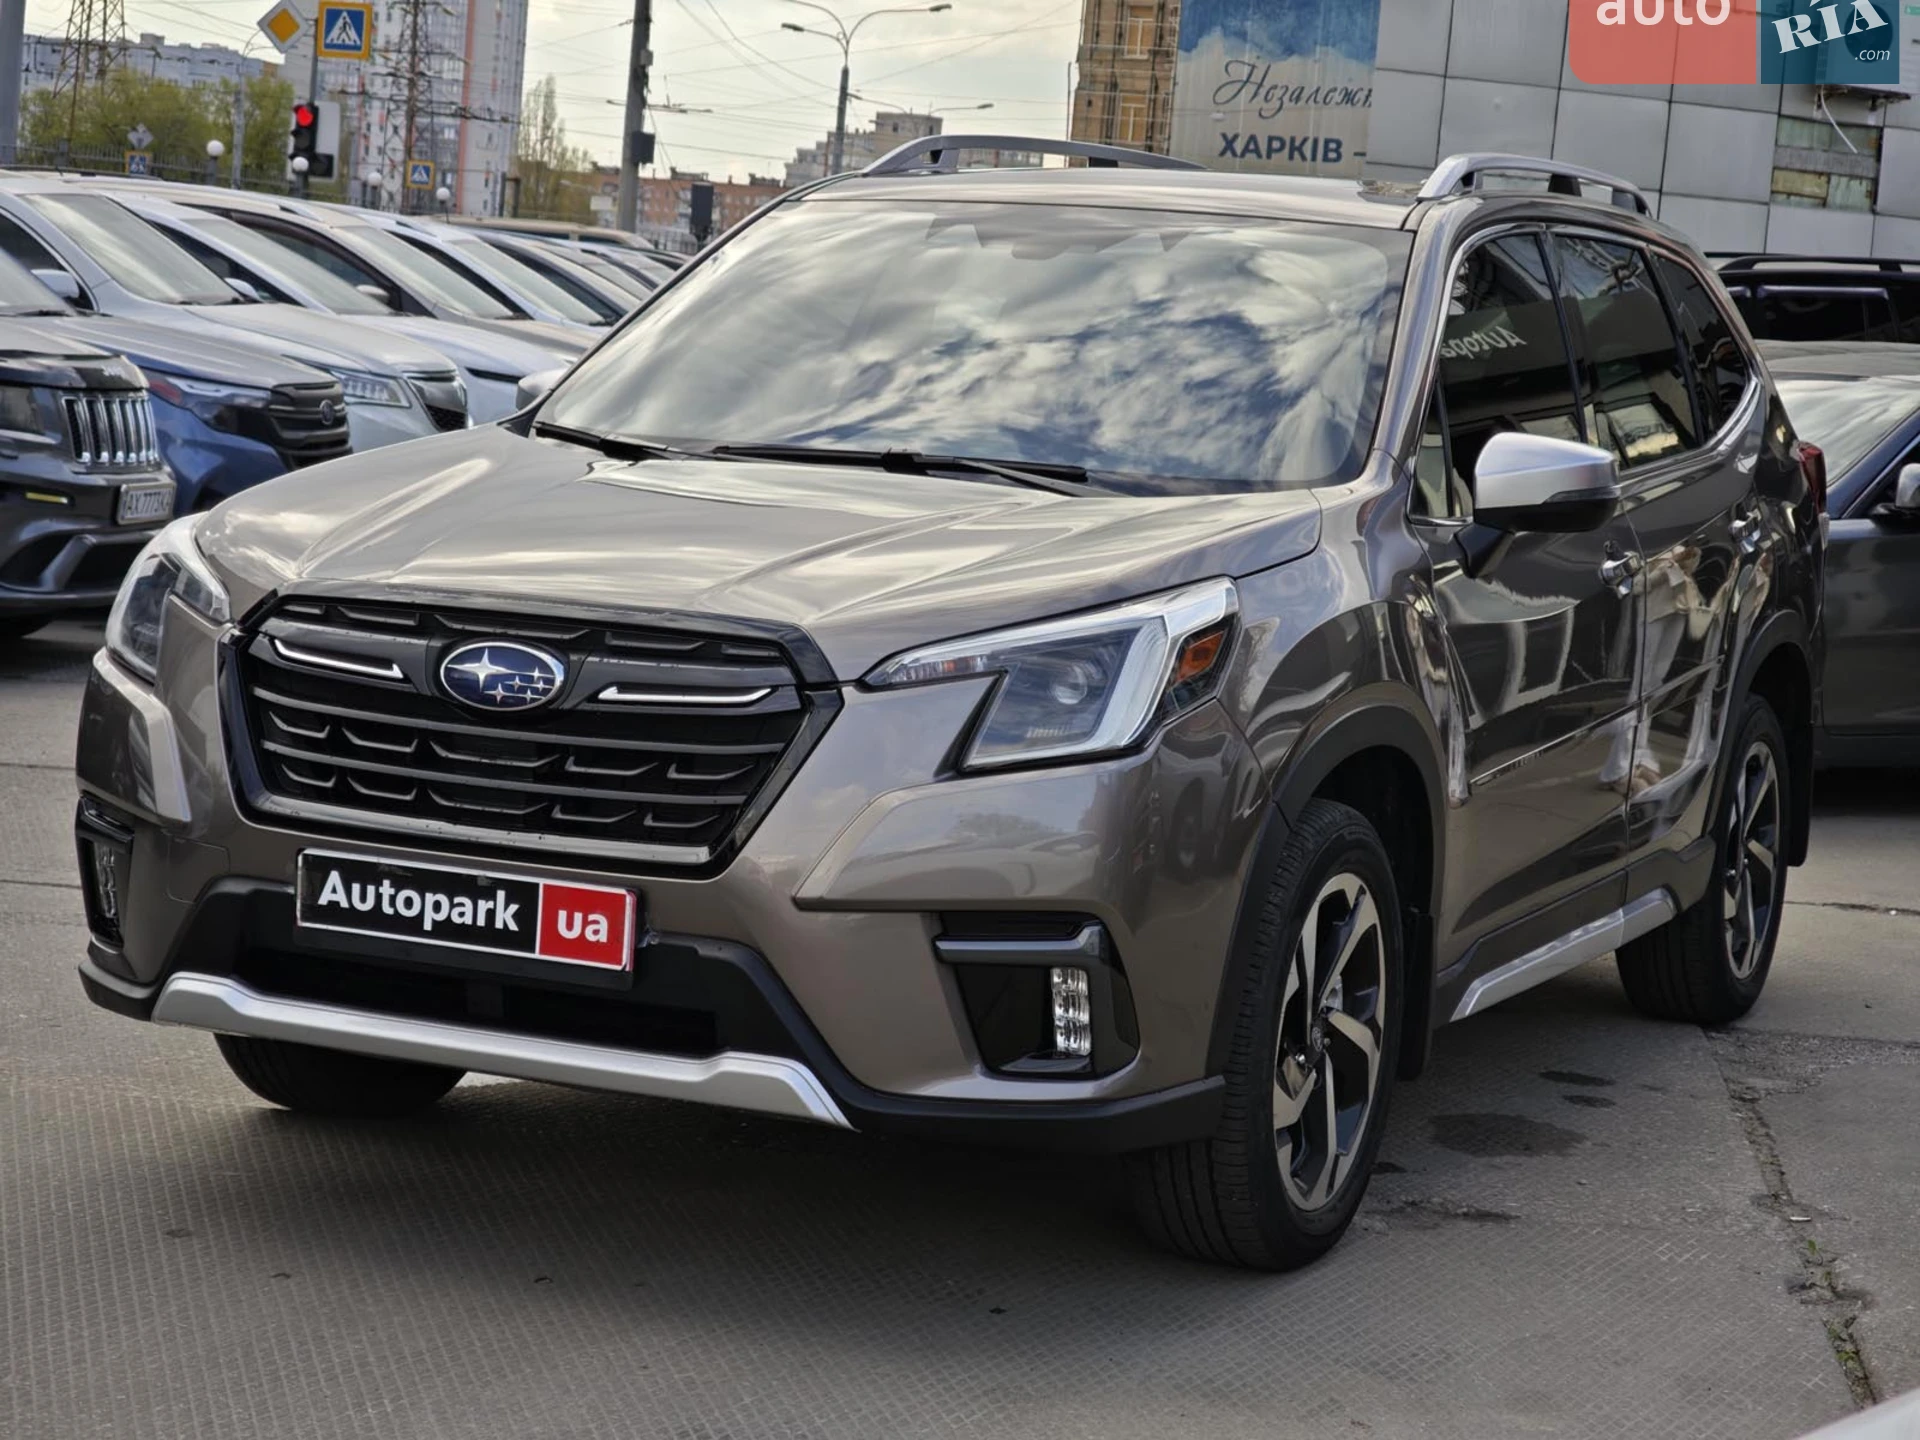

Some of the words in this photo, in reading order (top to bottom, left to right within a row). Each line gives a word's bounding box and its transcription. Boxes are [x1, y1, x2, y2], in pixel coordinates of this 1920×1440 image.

[1218, 131, 1344, 164] ХАРКІВ
[317, 870, 520, 932] Autopark
[557, 909, 609, 944] ua
